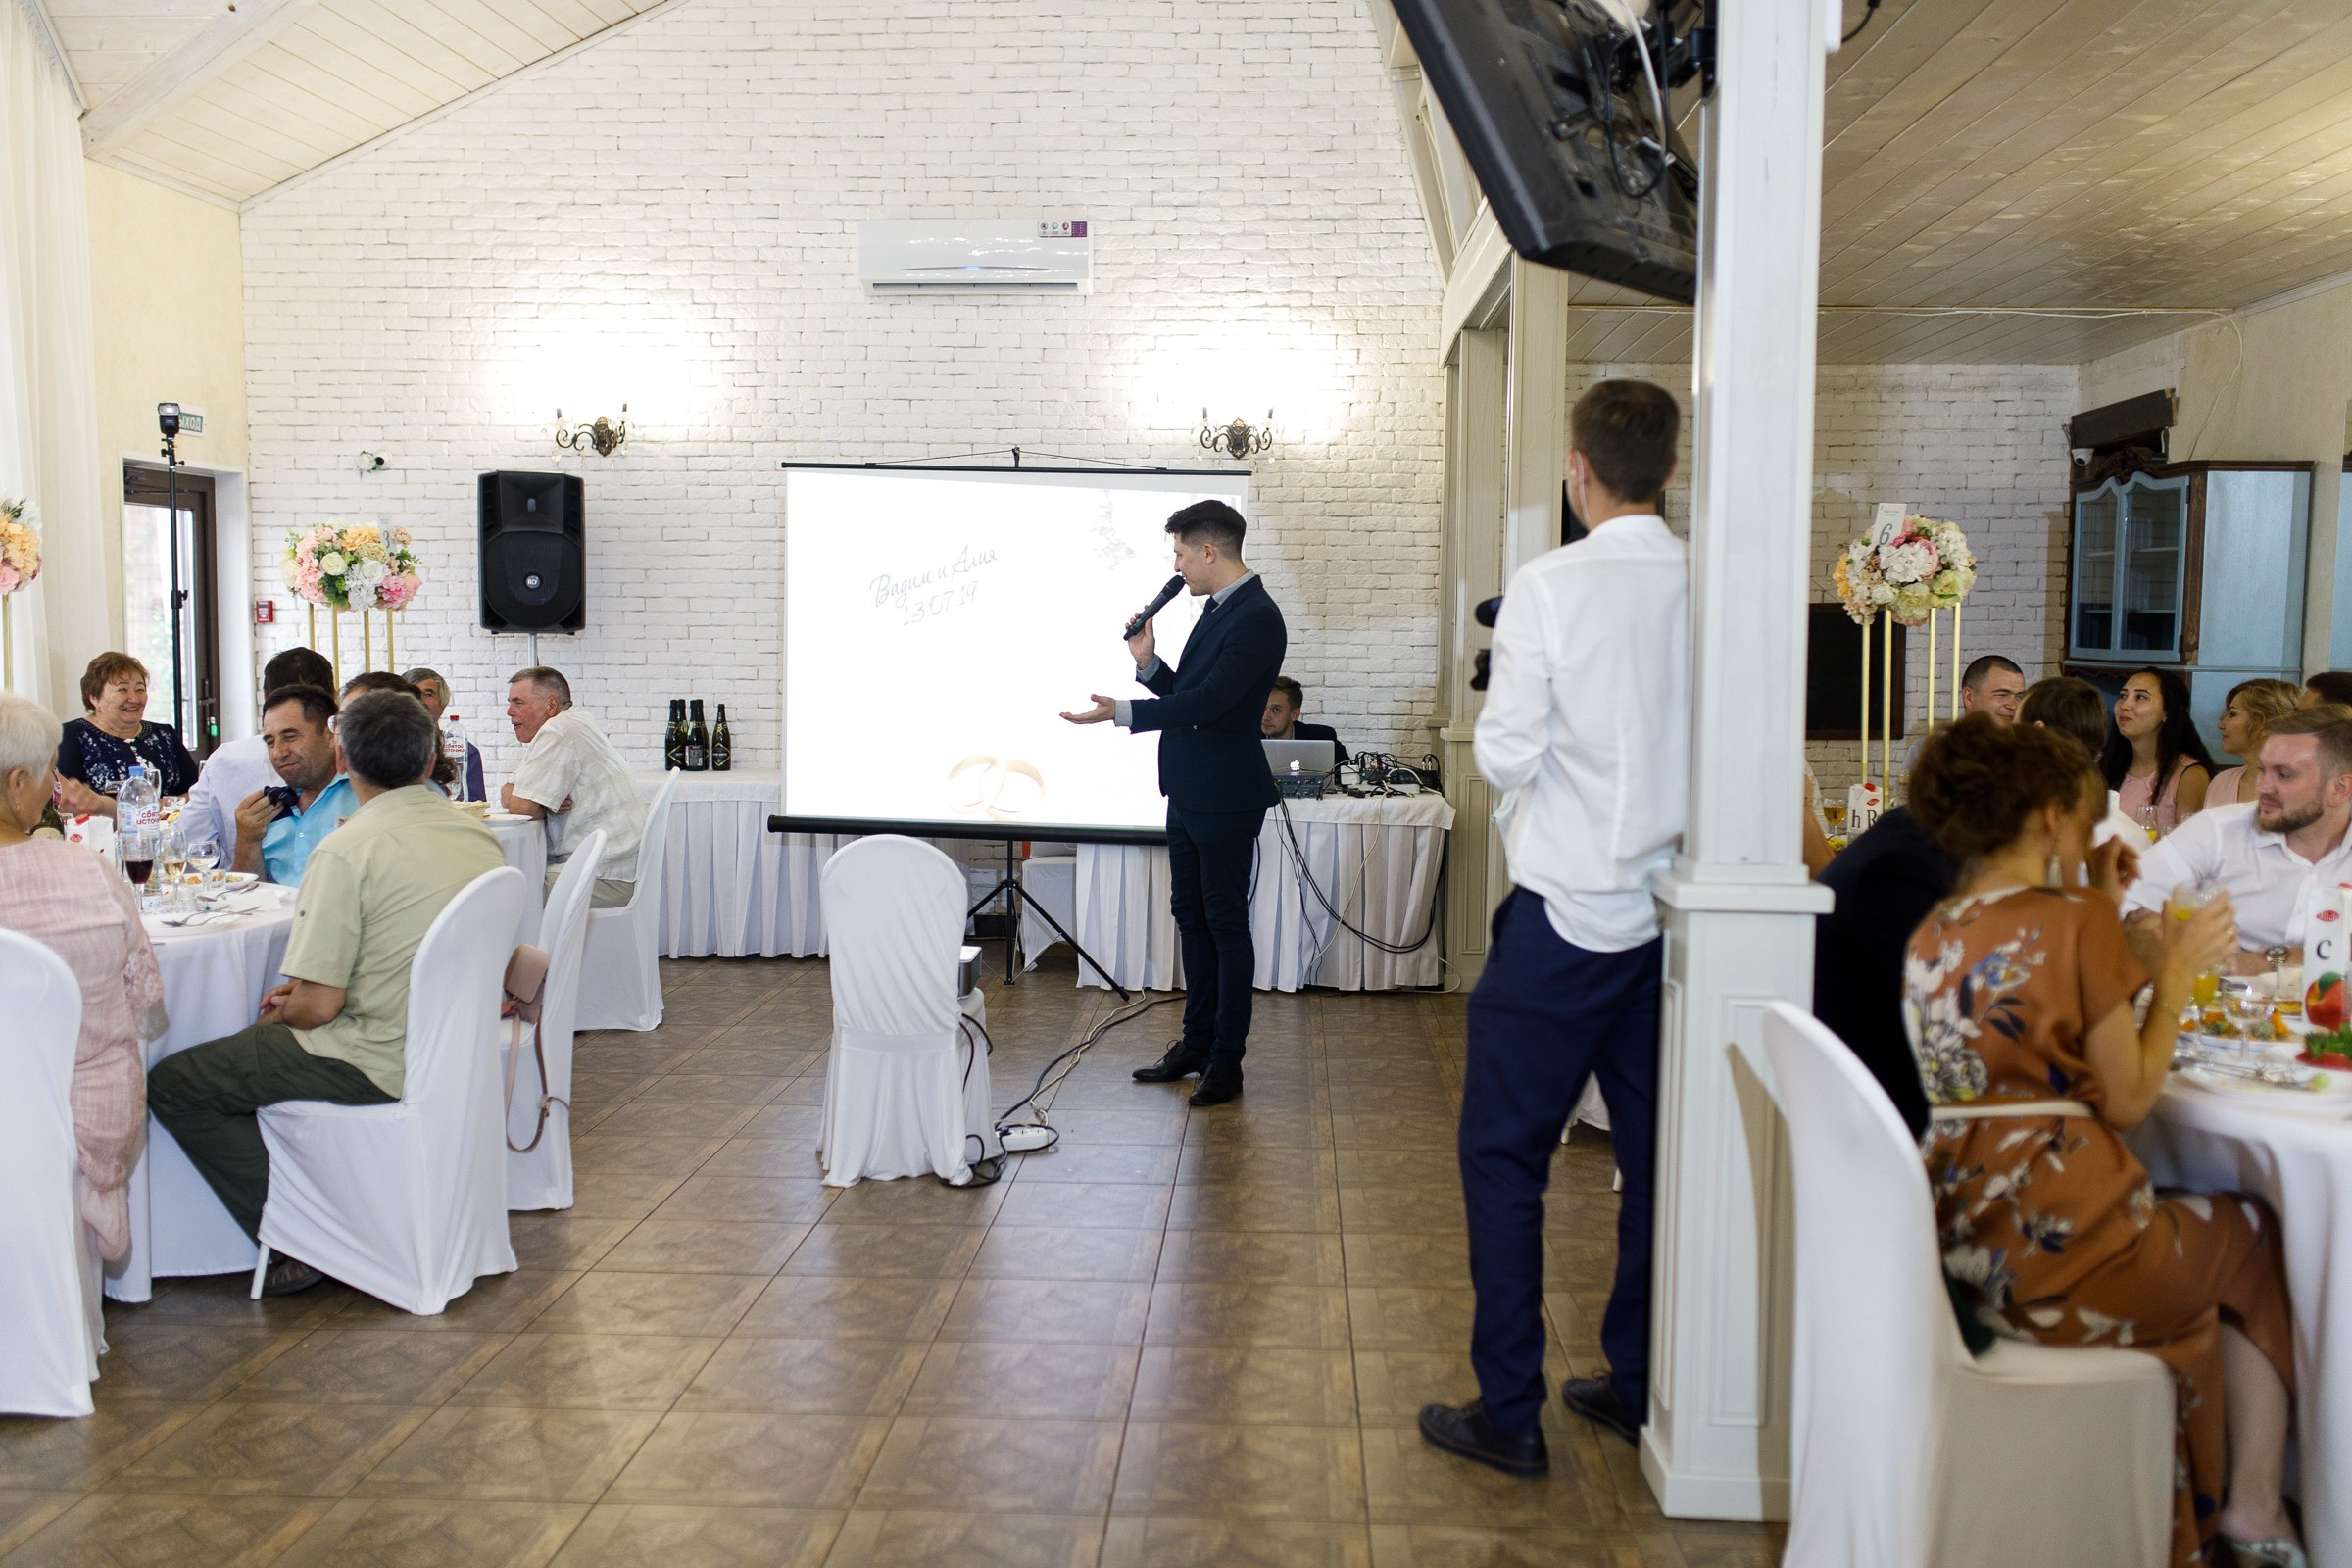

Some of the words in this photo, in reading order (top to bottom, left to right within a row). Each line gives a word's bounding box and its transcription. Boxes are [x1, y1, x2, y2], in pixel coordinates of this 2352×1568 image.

[178, 415, 202, 432] ЫХОД
[382, 530, 390, 549] 3
[1879, 523, 1893, 546] 6
[869, 571, 932, 609] Вадим
[938, 566, 948, 580] и
[951, 545, 999, 583] Алия
[902, 580, 979, 626] 13.07.19
